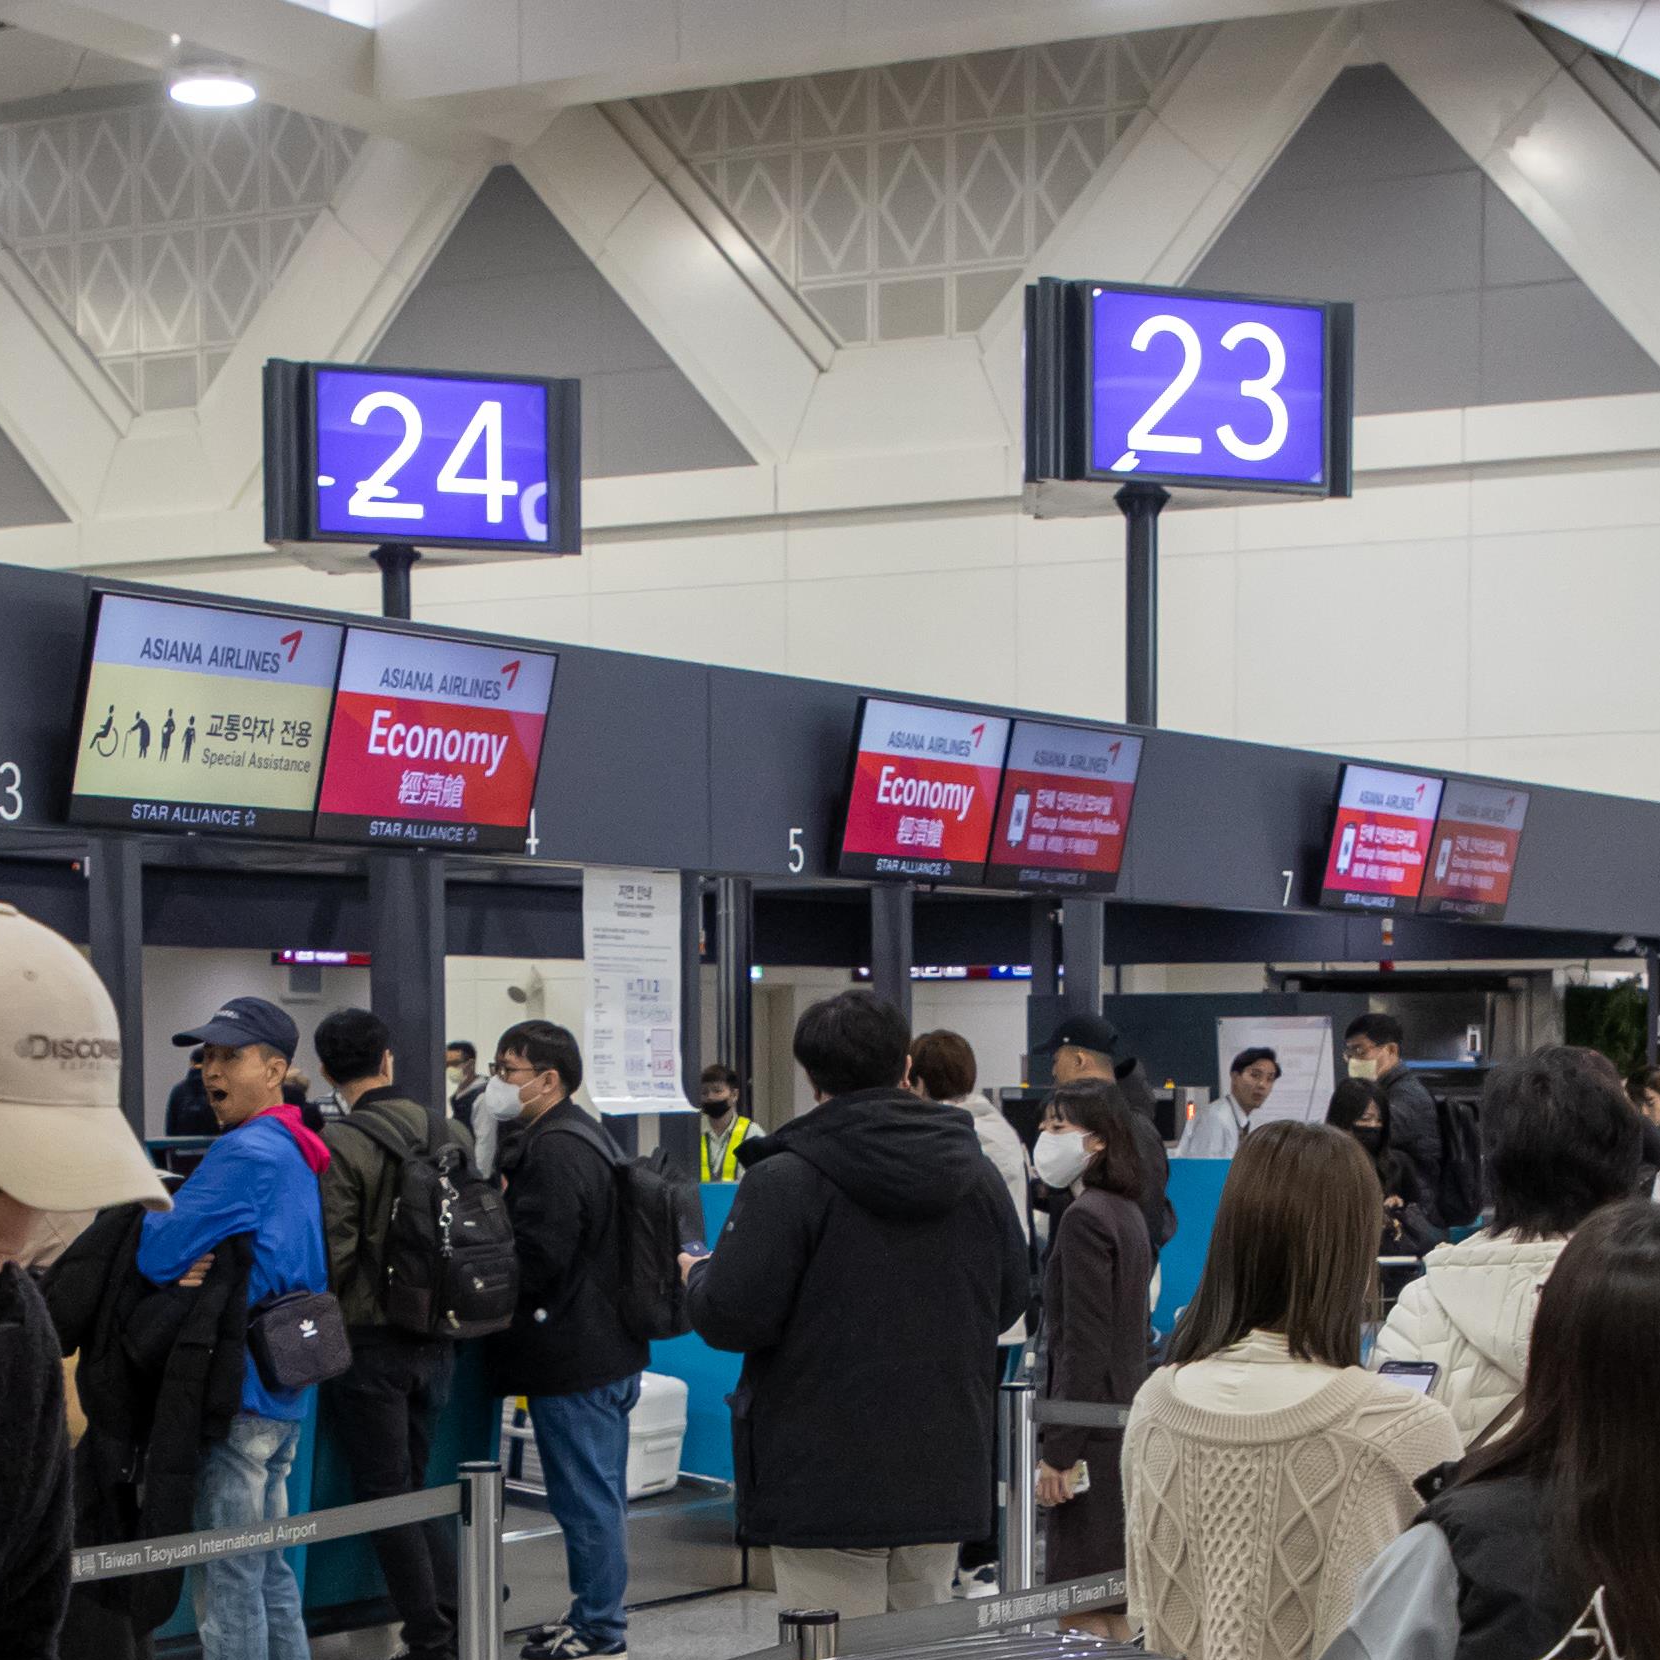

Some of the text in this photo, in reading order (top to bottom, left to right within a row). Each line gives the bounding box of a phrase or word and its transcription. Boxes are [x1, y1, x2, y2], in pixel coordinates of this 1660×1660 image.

[1127, 314, 1290, 462] 23
[347, 390, 519, 521] 24
[139, 636, 281, 675] ASIANA AIRLINES
[379, 667, 501, 701] ASIANA AIRLINES
[206, 713, 313, 750] 교통약자 전용
[367, 709, 509, 777] Economy
[886, 730, 971, 758] ASIANA AIRLINES
[201, 748, 312, 775] Special Assistance
[397, 769, 466, 810] 經濟艙
[876, 765, 976, 822] Economy
[131, 802, 241, 828] STAR ALLIANCE
[369, 820, 465, 844] STAR ALLIANCE
[787, 827, 805, 873] 5
[875, 857, 943, 876] STAR ALLIANCE
[98, 1550, 141, 1570] Taiwan
[143, 1543, 197, 1565] Taoyuan
[199, 1526, 274, 1555] International
[275, 1520, 318, 1544] Airport
[1070, 1583, 1107, 1605] Taiwan
